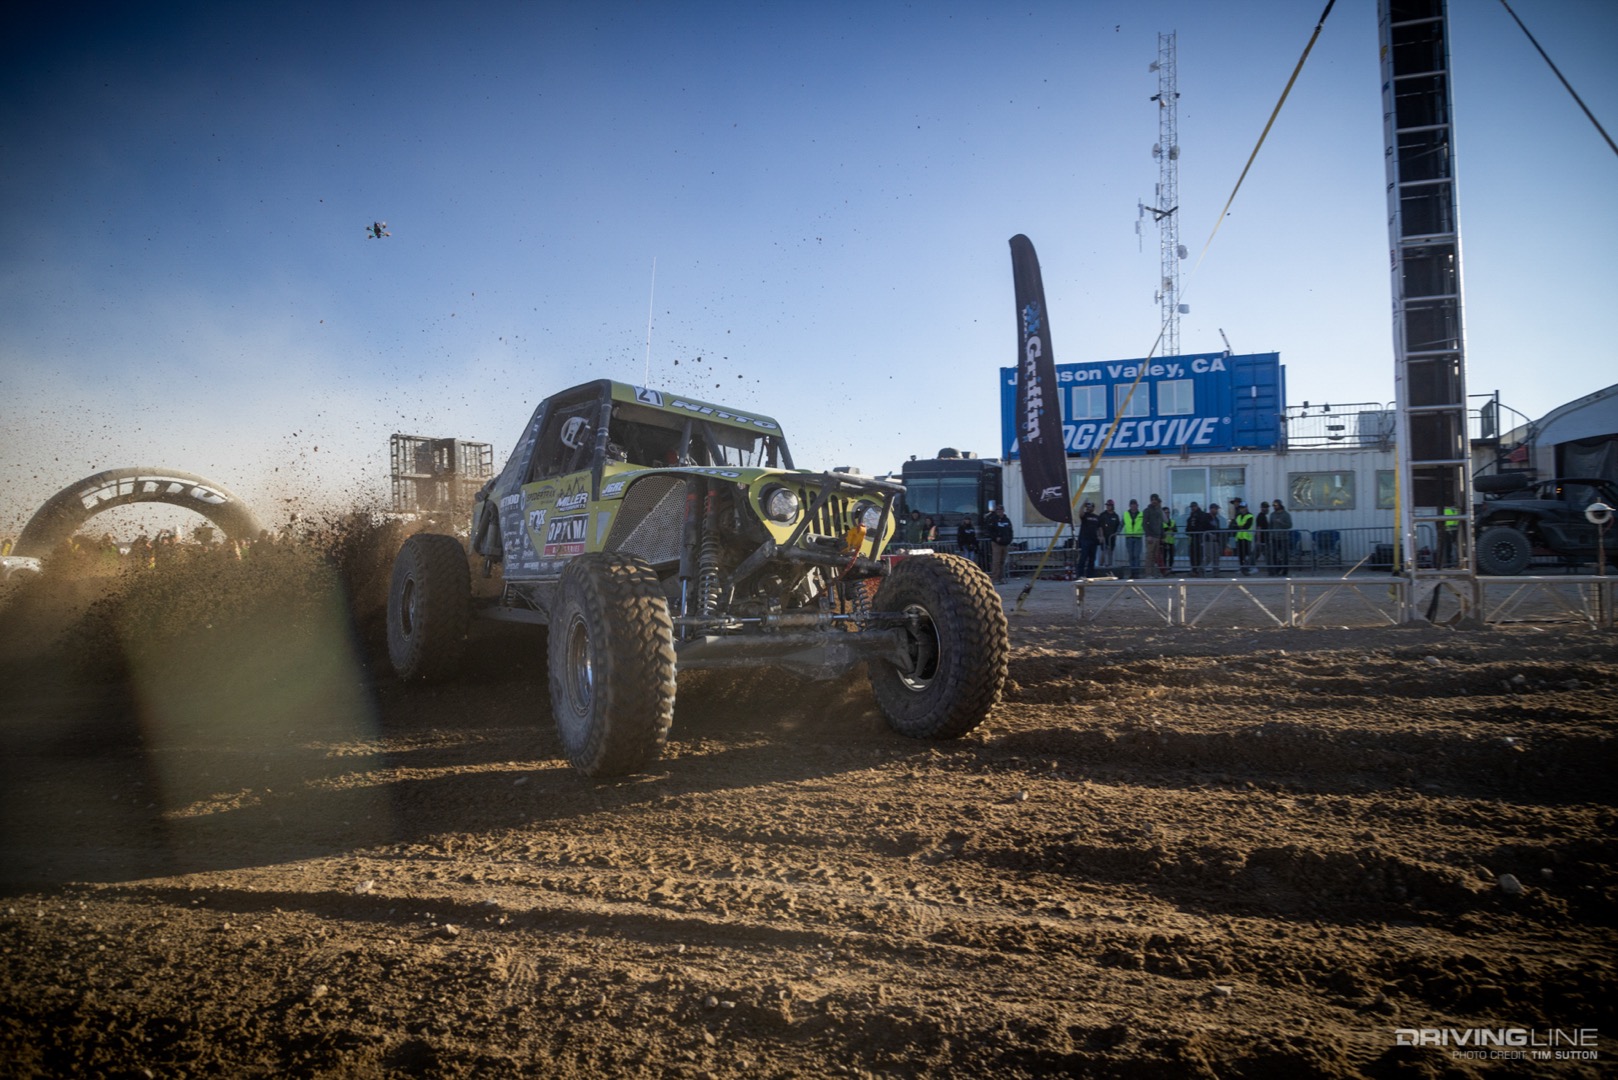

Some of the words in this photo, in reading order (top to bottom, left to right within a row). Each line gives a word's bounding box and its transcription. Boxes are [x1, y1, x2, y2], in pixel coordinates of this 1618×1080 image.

[1008, 368, 1102, 385] Json
[1107, 363, 1184, 379] Valley,
[1191, 358, 1226, 373] CA
[636, 386, 662, 404] 21
[670, 400, 777, 429] NITTO
[1011, 417, 1219, 453] OGRESSIVE
[79, 476, 228, 510] NITTO
[556, 492, 588, 507] MILLER
[528, 509, 547, 527] FOX
